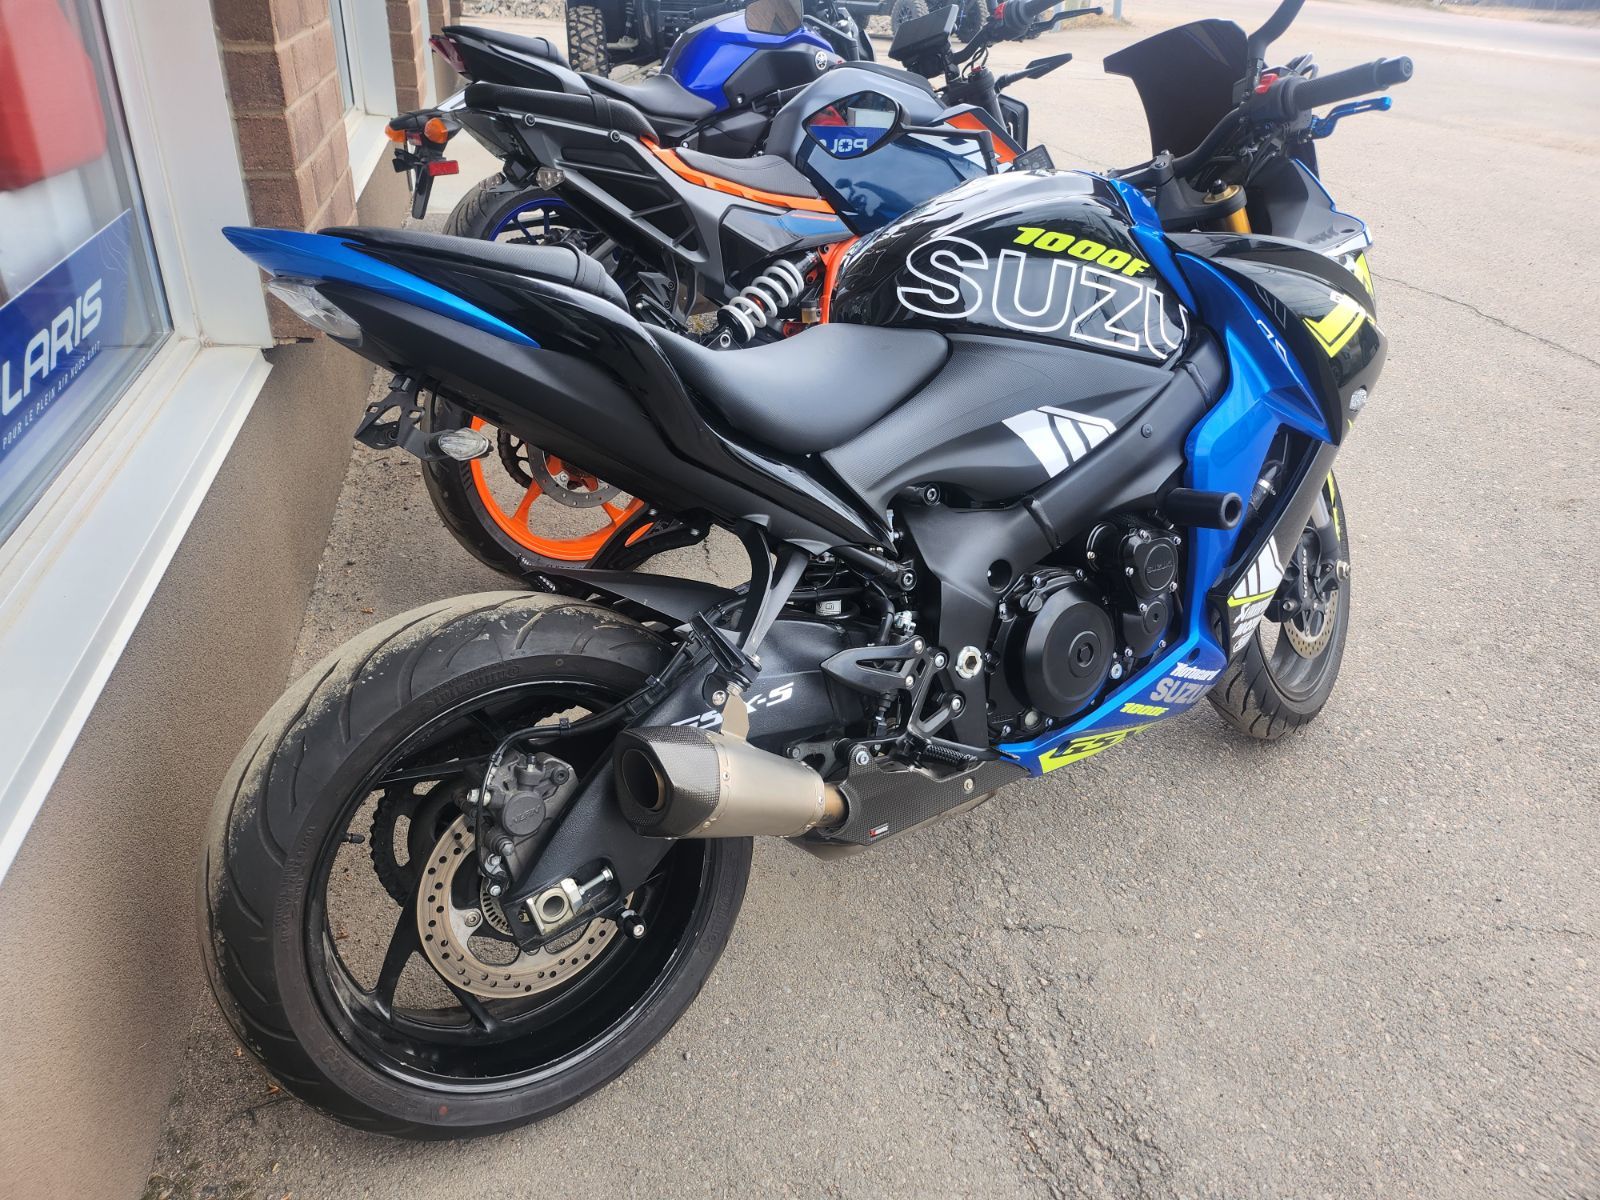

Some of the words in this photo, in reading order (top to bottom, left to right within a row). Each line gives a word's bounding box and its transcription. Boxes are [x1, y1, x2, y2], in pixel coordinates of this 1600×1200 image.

[1013, 226, 1150, 277] 1000F
[2, 278, 102, 416] LARIS
[3, 421, 22, 450] POUR
[24, 408, 34, 426] LE
[36, 385, 56, 415] PLEIN
[58, 374, 69, 391] AIR
